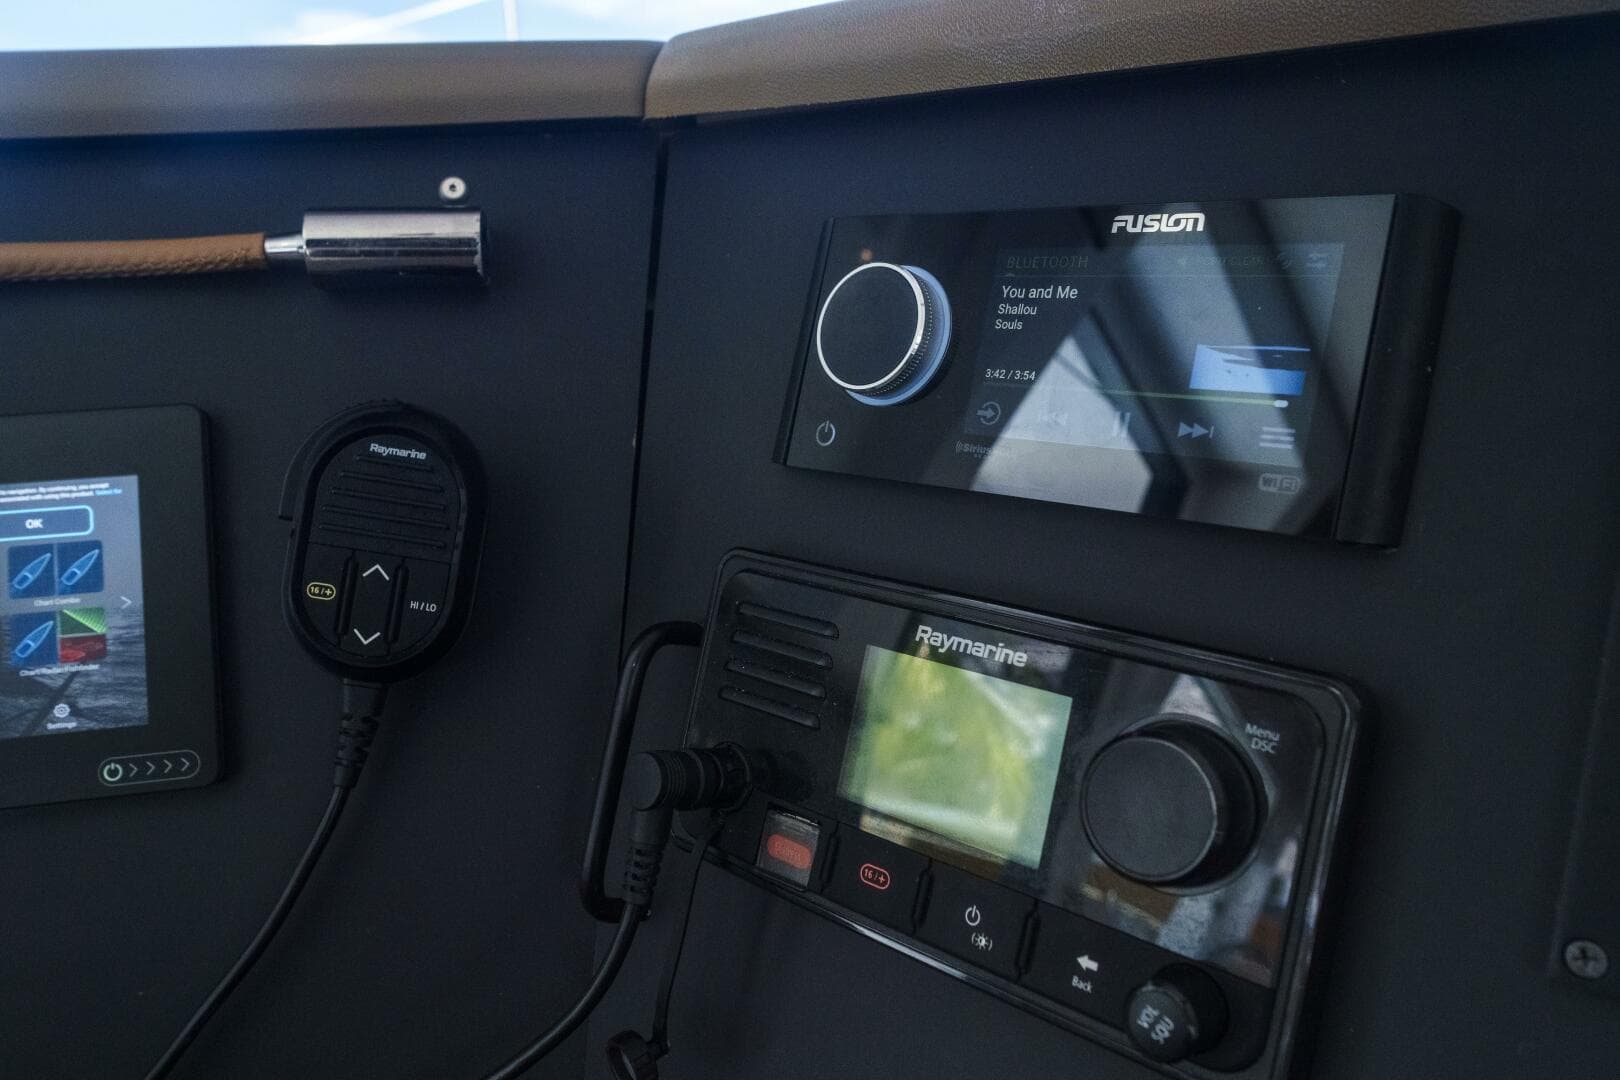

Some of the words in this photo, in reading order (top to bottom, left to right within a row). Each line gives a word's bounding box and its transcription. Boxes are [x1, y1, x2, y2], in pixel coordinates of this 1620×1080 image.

[1111, 212, 1206, 234] FUSION
[1006, 254, 1090, 270] BLUETOOTH
[1002, 285, 1026, 299] You
[1028, 285, 1053, 299] and
[1056, 286, 1079, 300] Me
[997, 303, 1037, 315] Shallou
[994, 318, 1023, 330] Souls
[985, 368, 1006, 379] 3:42
[1014, 370, 1036, 381] 3:54
[369, 442, 427, 461] Raymarine
[25, 518, 44, 530] OK
[914, 624, 1028, 668] Raymarine
[1245, 723, 1281, 742] Menu
[1071, 975, 1093, 994] Back
